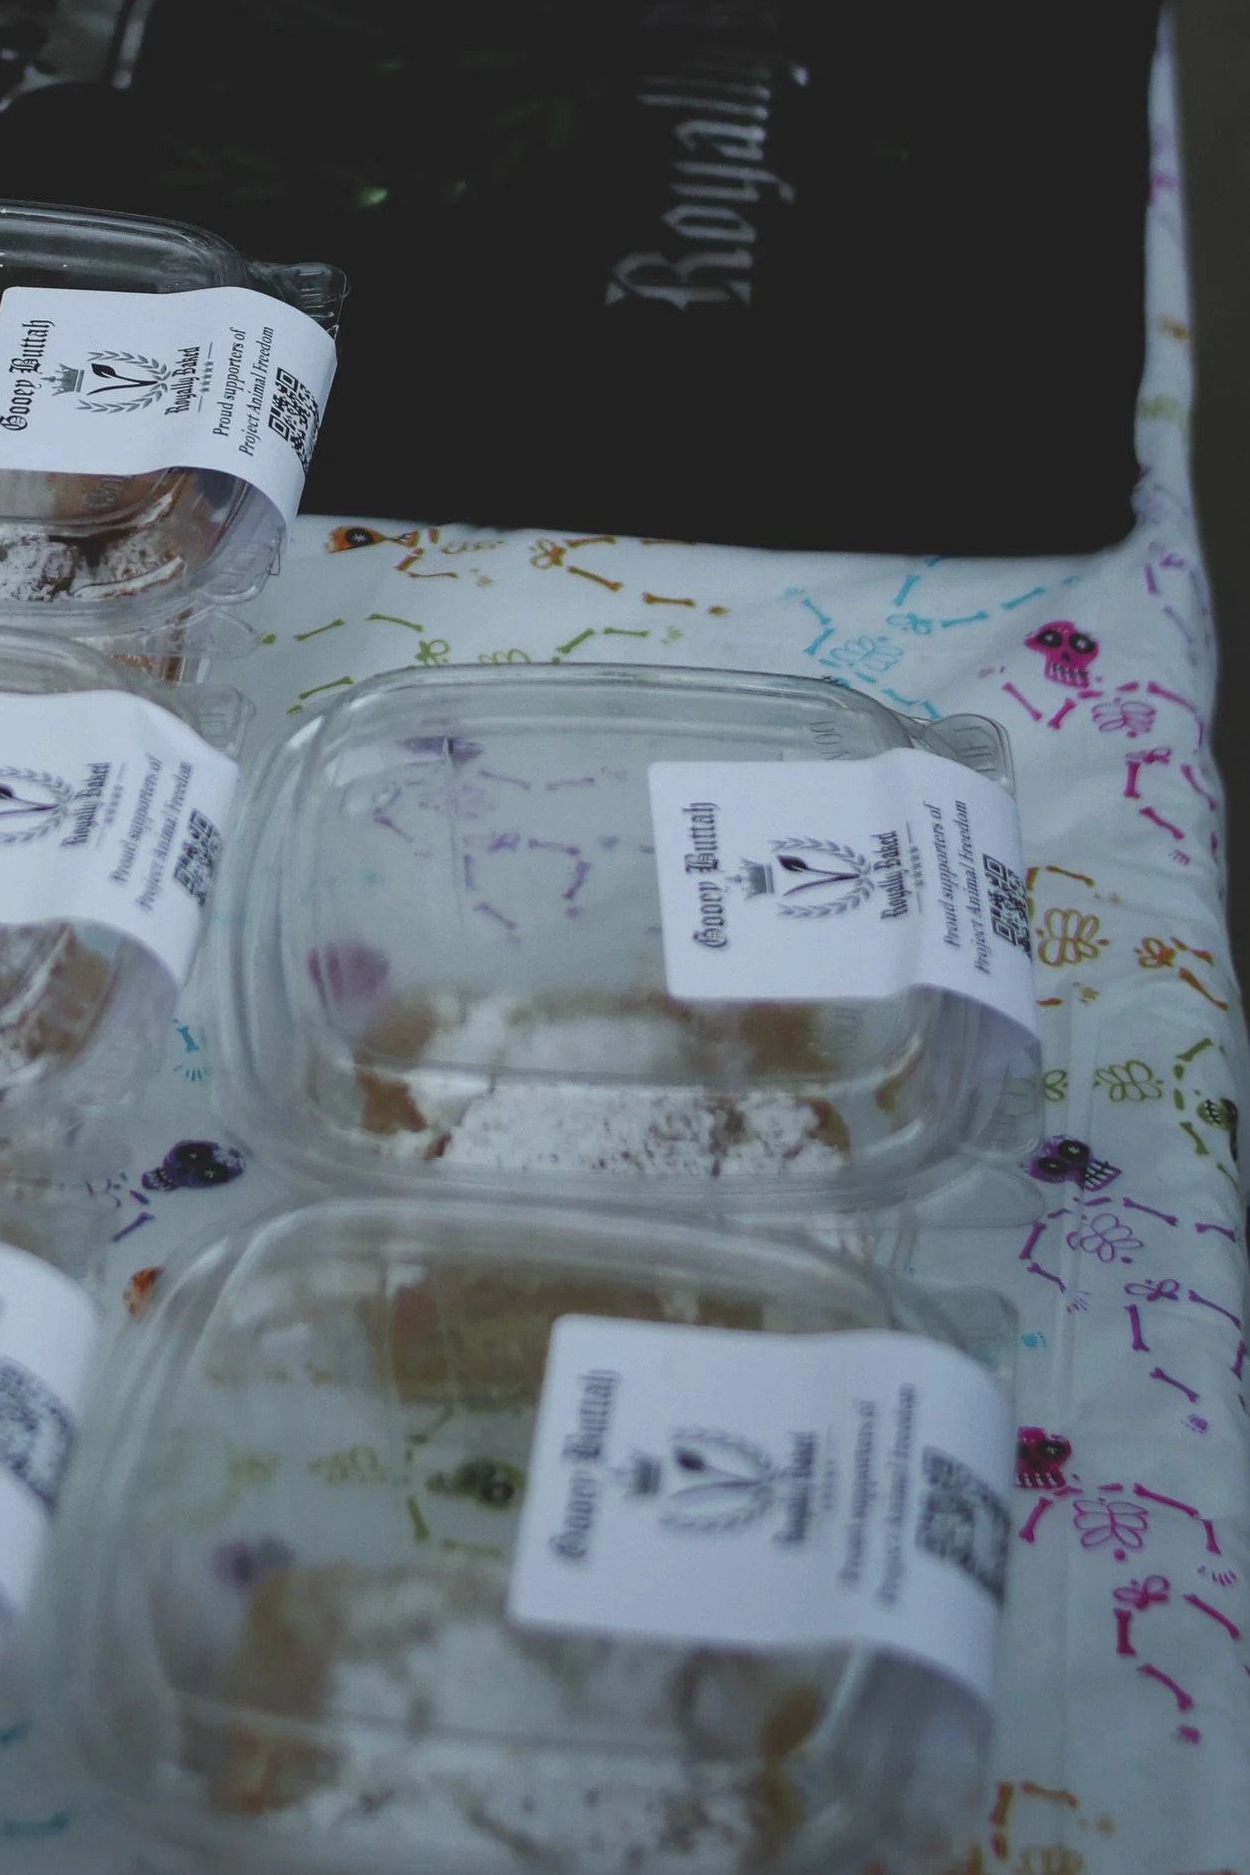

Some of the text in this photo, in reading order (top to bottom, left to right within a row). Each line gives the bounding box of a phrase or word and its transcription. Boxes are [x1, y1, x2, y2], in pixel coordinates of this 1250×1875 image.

[8, 318, 55, 374] Buttah
[164, 345, 201, 416] Royally Baked
[212, 327, 246, 437] Proud supporters of
[238, 325, 275, 457] Project Animal Freedom
[682, 801, 730, 950] Gooey Buttah
[870, 829, 912, 921] Royally Baked
[923, 800, 962, 949] Proud supporters of
[954, 799, 992, 975] Project Animal Freedom
